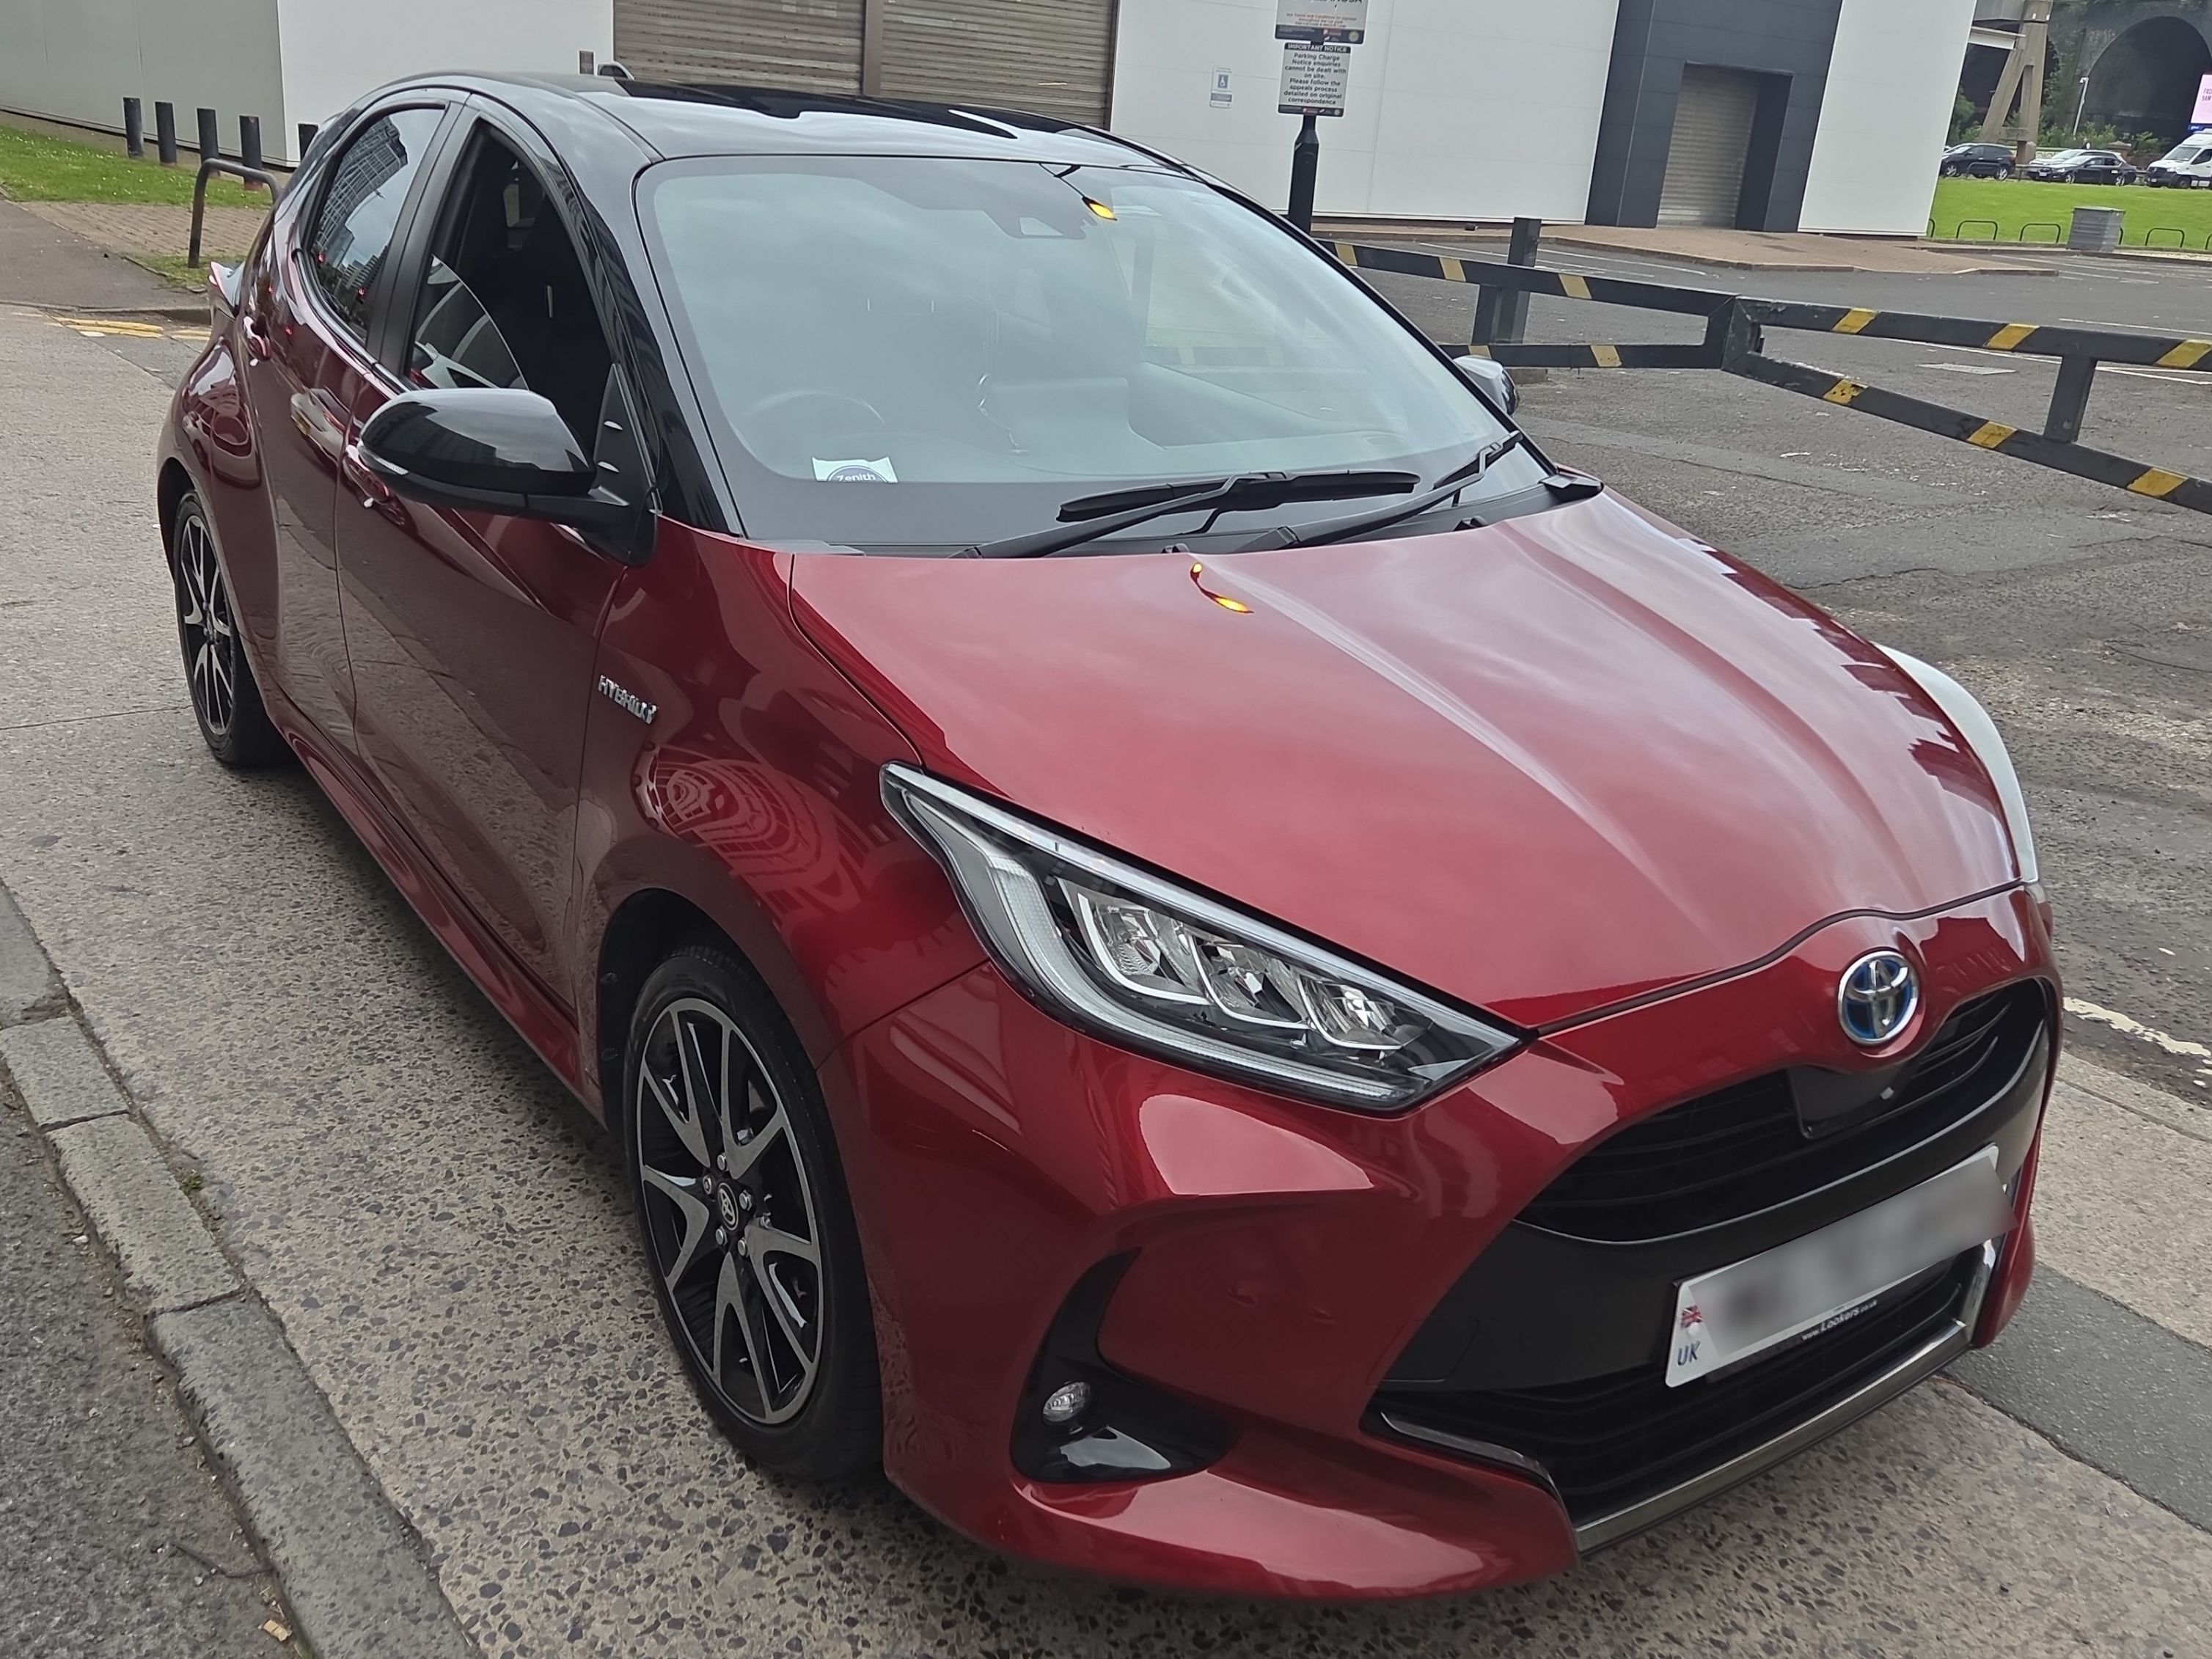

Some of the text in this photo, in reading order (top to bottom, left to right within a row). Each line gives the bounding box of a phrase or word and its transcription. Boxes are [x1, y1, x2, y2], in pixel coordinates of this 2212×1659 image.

[1288, 43, 1323, 51] IMPORTANT
[1288, 97, 1336, 105] correspondence
[836, 473, 875, 482] Zenith
[1677, 1341, 1701, 1366] UK
